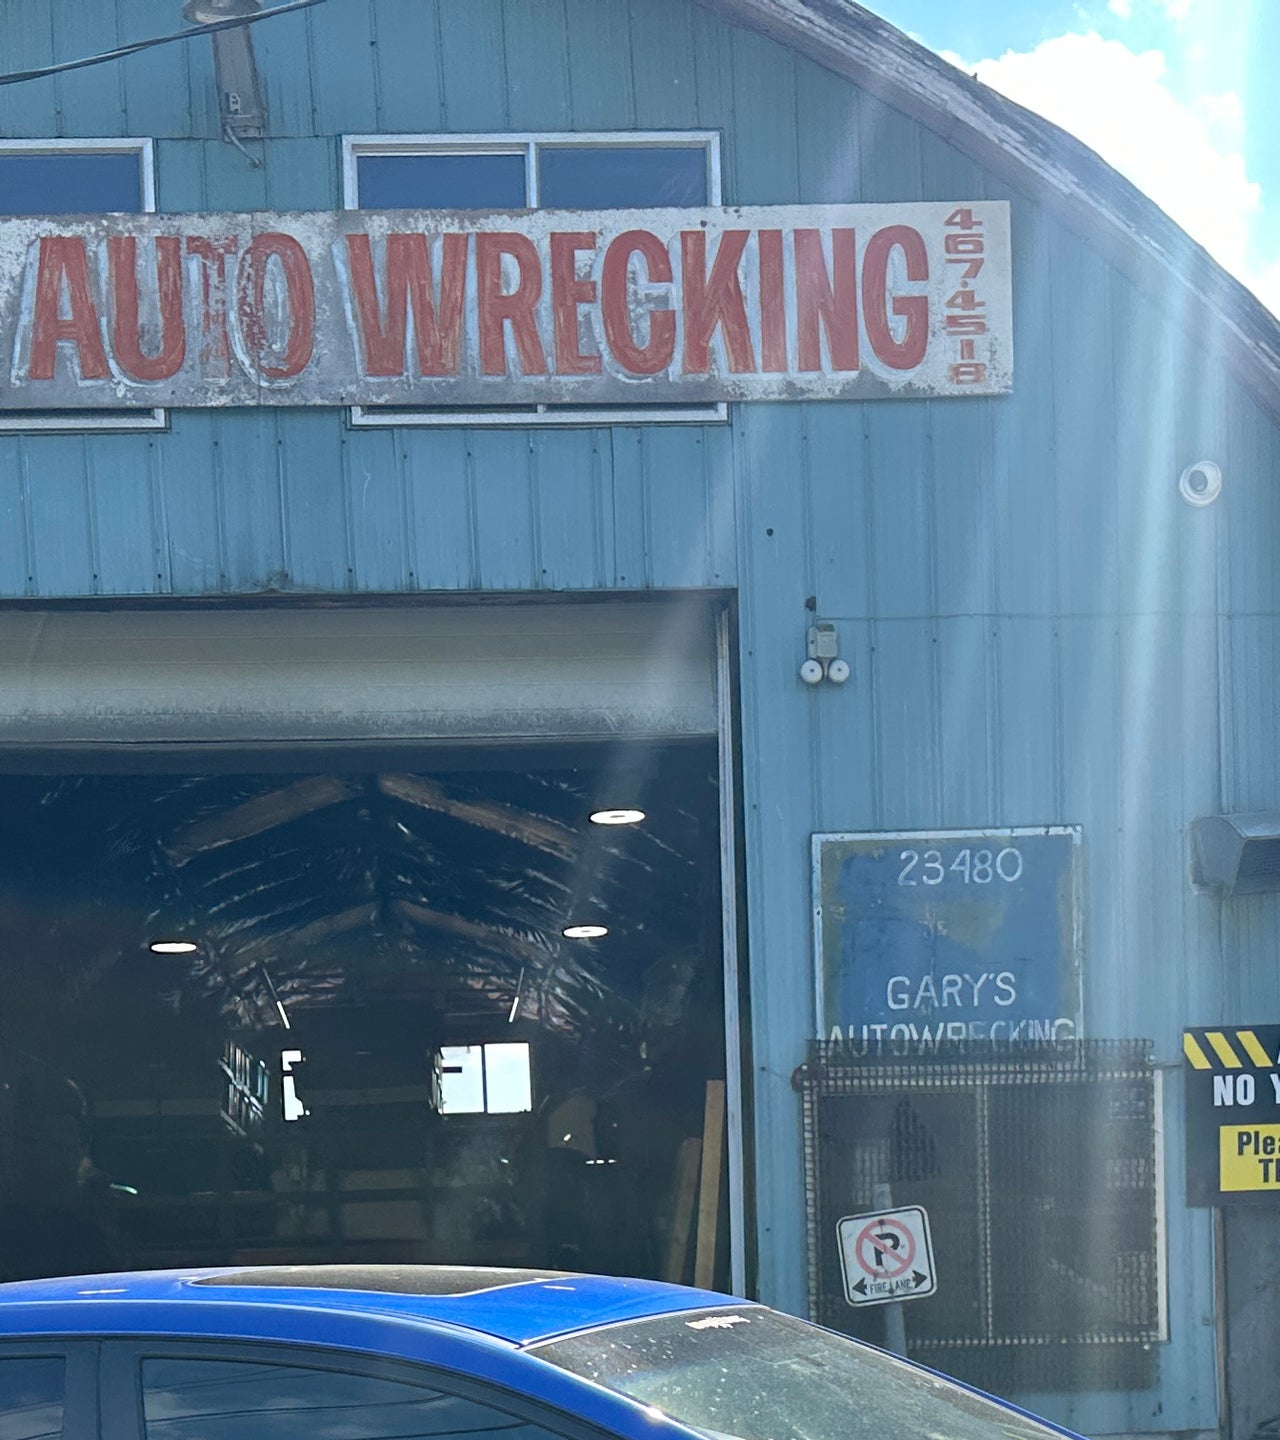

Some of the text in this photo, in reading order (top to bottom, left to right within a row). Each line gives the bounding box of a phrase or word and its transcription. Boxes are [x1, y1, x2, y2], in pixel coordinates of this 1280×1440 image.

[28, 232, 315, 381] AUTO
[346, 225, 930, 378] WRECKING
[897, 847, 1023, 886] 23480
[887, 971, 1016, 1010] GARY'S
[1213, 1073, 1255, 1106] NO
[870, 1282, 888, 1294] FIRE
